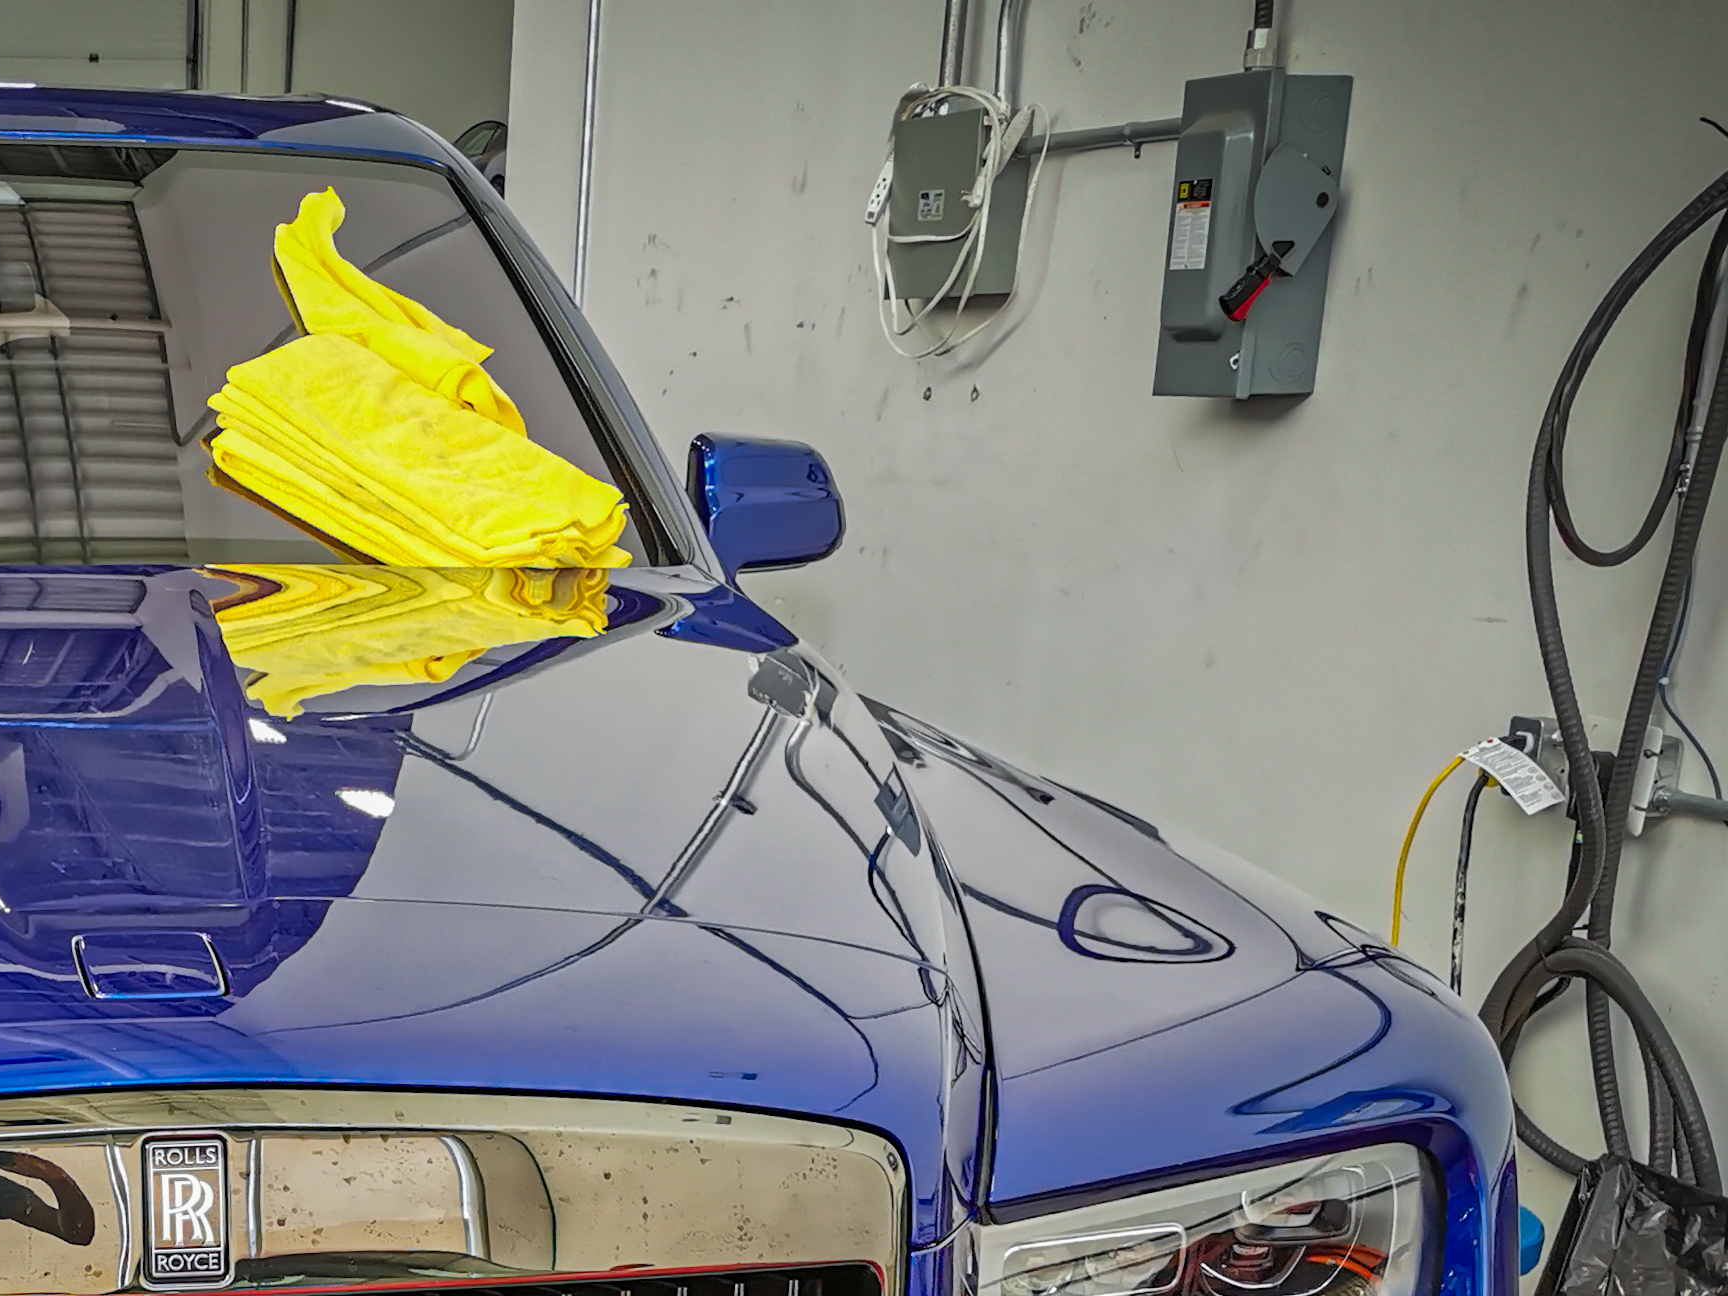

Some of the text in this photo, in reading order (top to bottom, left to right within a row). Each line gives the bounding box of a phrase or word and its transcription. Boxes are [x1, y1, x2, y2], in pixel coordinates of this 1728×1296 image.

[155, 1148, 216, 1166] ROLLS
[161, 1173, 215, 1246] RR
[157, 1254, 220, 1271] ROYCE
